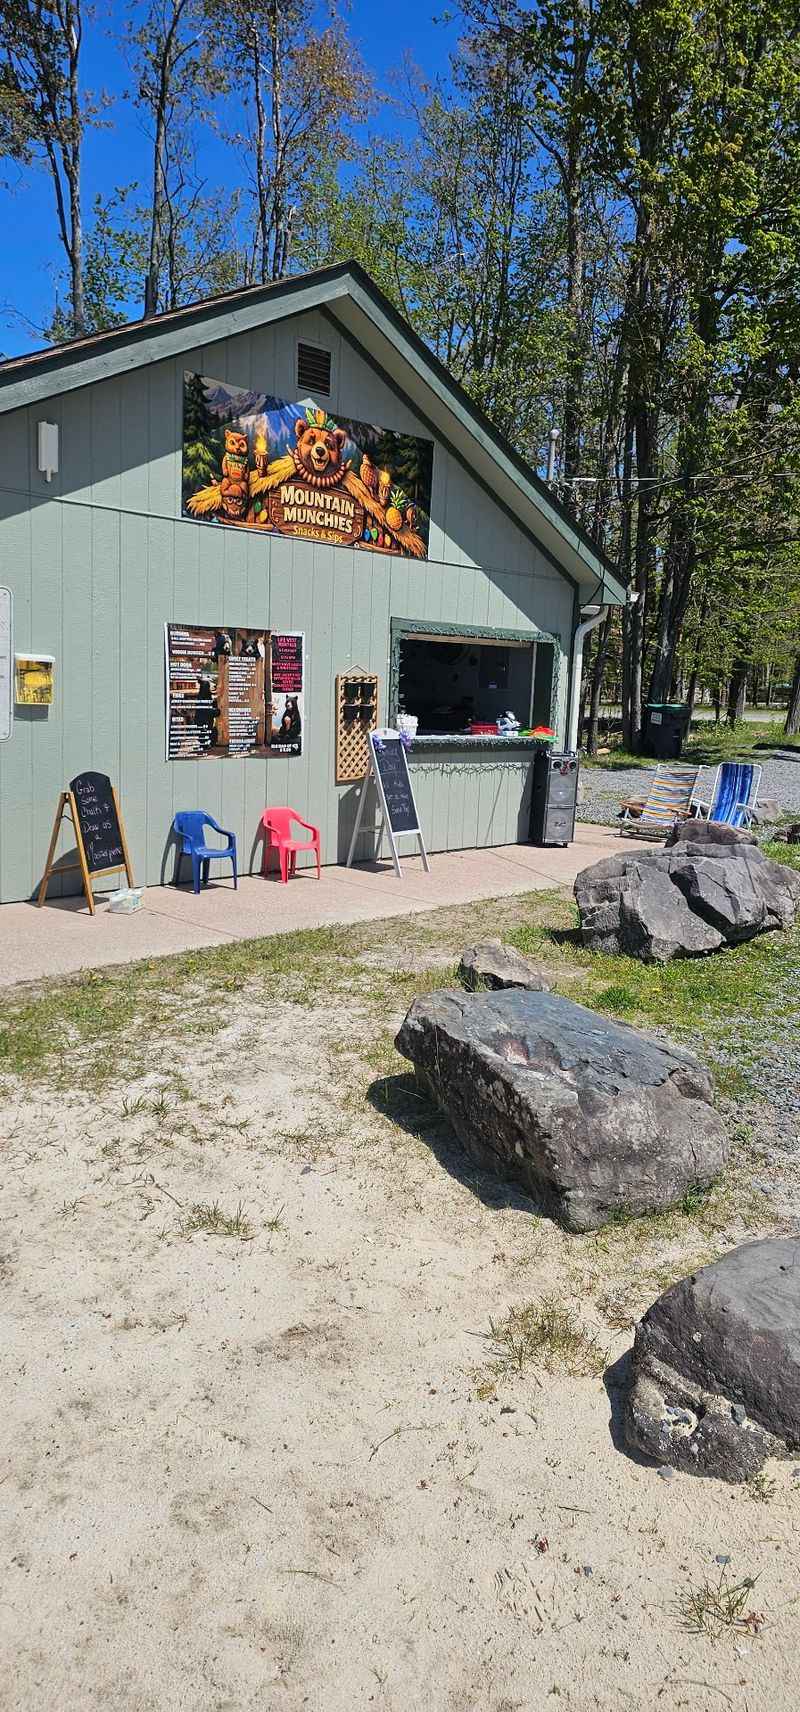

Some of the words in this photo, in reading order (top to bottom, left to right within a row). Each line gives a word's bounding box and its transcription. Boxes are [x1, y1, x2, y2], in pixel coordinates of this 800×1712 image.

[280, 485, 355, 517] MOUNTAIN
[283, 507, 353, 534] MUNCHIES
[293, 525, 320, 539] Snacks
[327, 531, 343, 544] Sips
[76, 780, 95, 794] Grab
